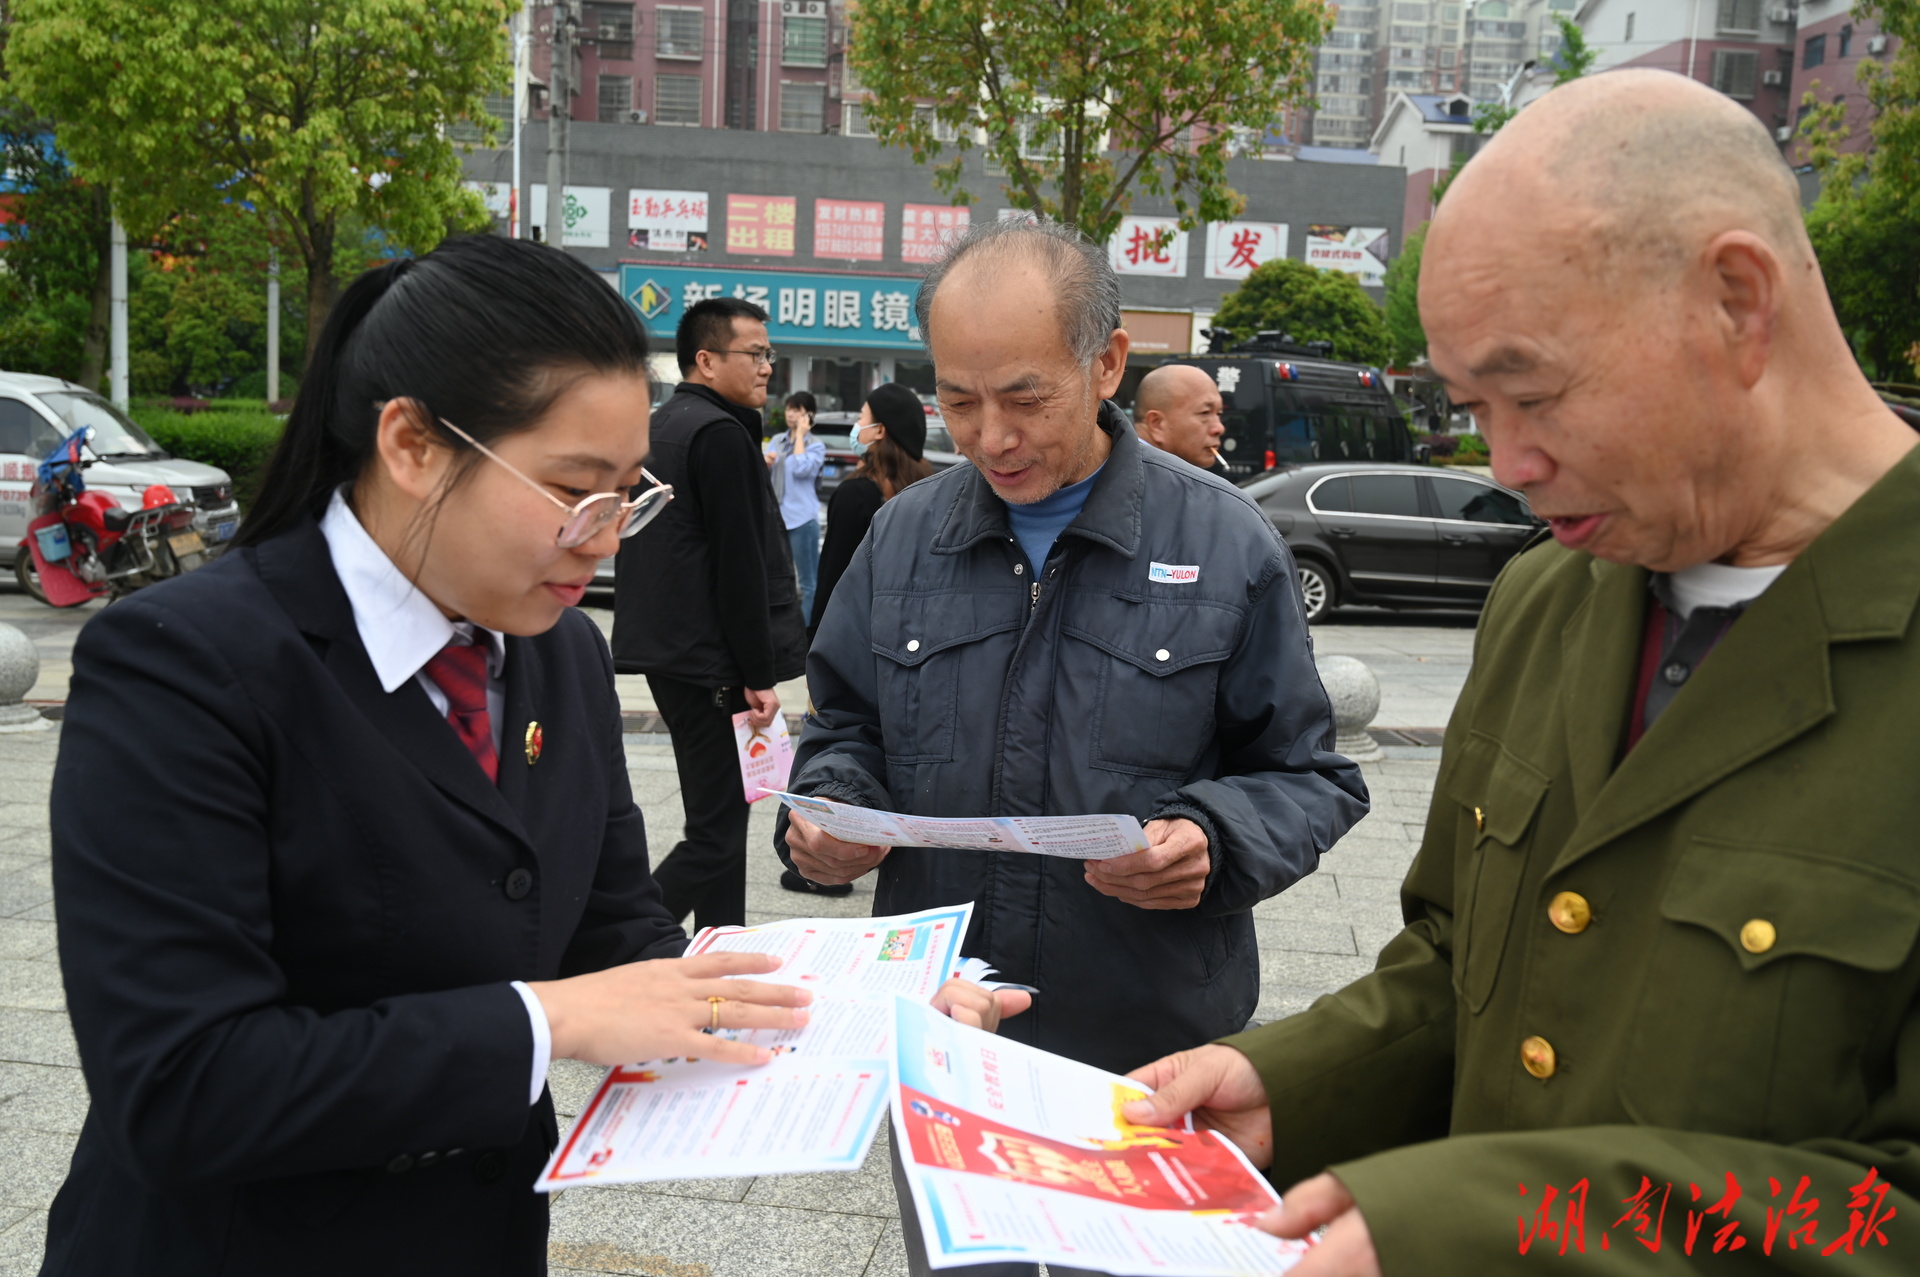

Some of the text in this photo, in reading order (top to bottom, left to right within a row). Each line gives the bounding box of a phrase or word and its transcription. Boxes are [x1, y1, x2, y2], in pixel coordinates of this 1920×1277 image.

[728, 202, 794, 225] 二楼
[728, 226, 795, 250] 出租
[1125, 225, 1171, 265] 批
[1225, 228, 1263, 270] 发
[1216, 366, 1241, 393] 警
[1151, 566, 1197, 580] NTN-YULON
